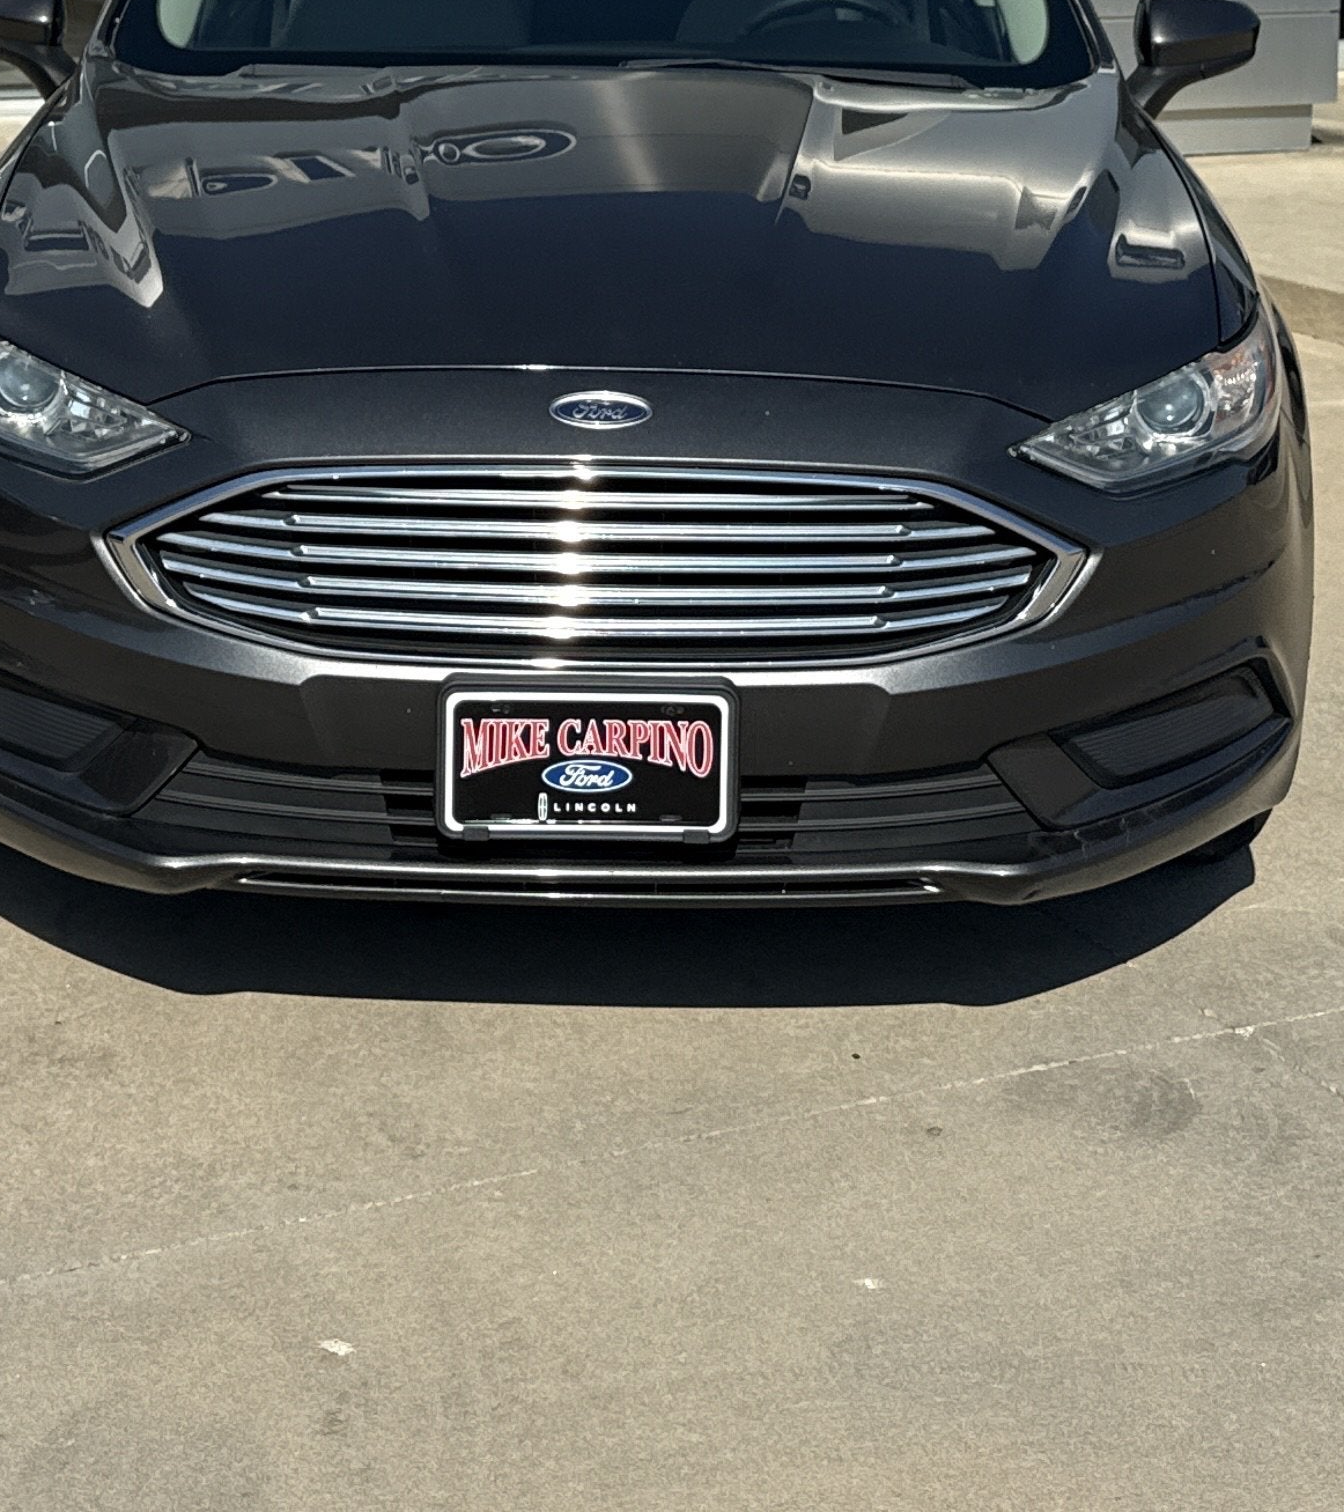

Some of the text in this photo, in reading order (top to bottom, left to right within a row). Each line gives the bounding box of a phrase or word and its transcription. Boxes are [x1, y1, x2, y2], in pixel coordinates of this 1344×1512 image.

[571, 402, 629, 420] Ford
[460, 718, 714, 778] MIKE CARPINO
[559, 763, 615, 788] Ford
[553, 801, 637, 813] LINCOLN
